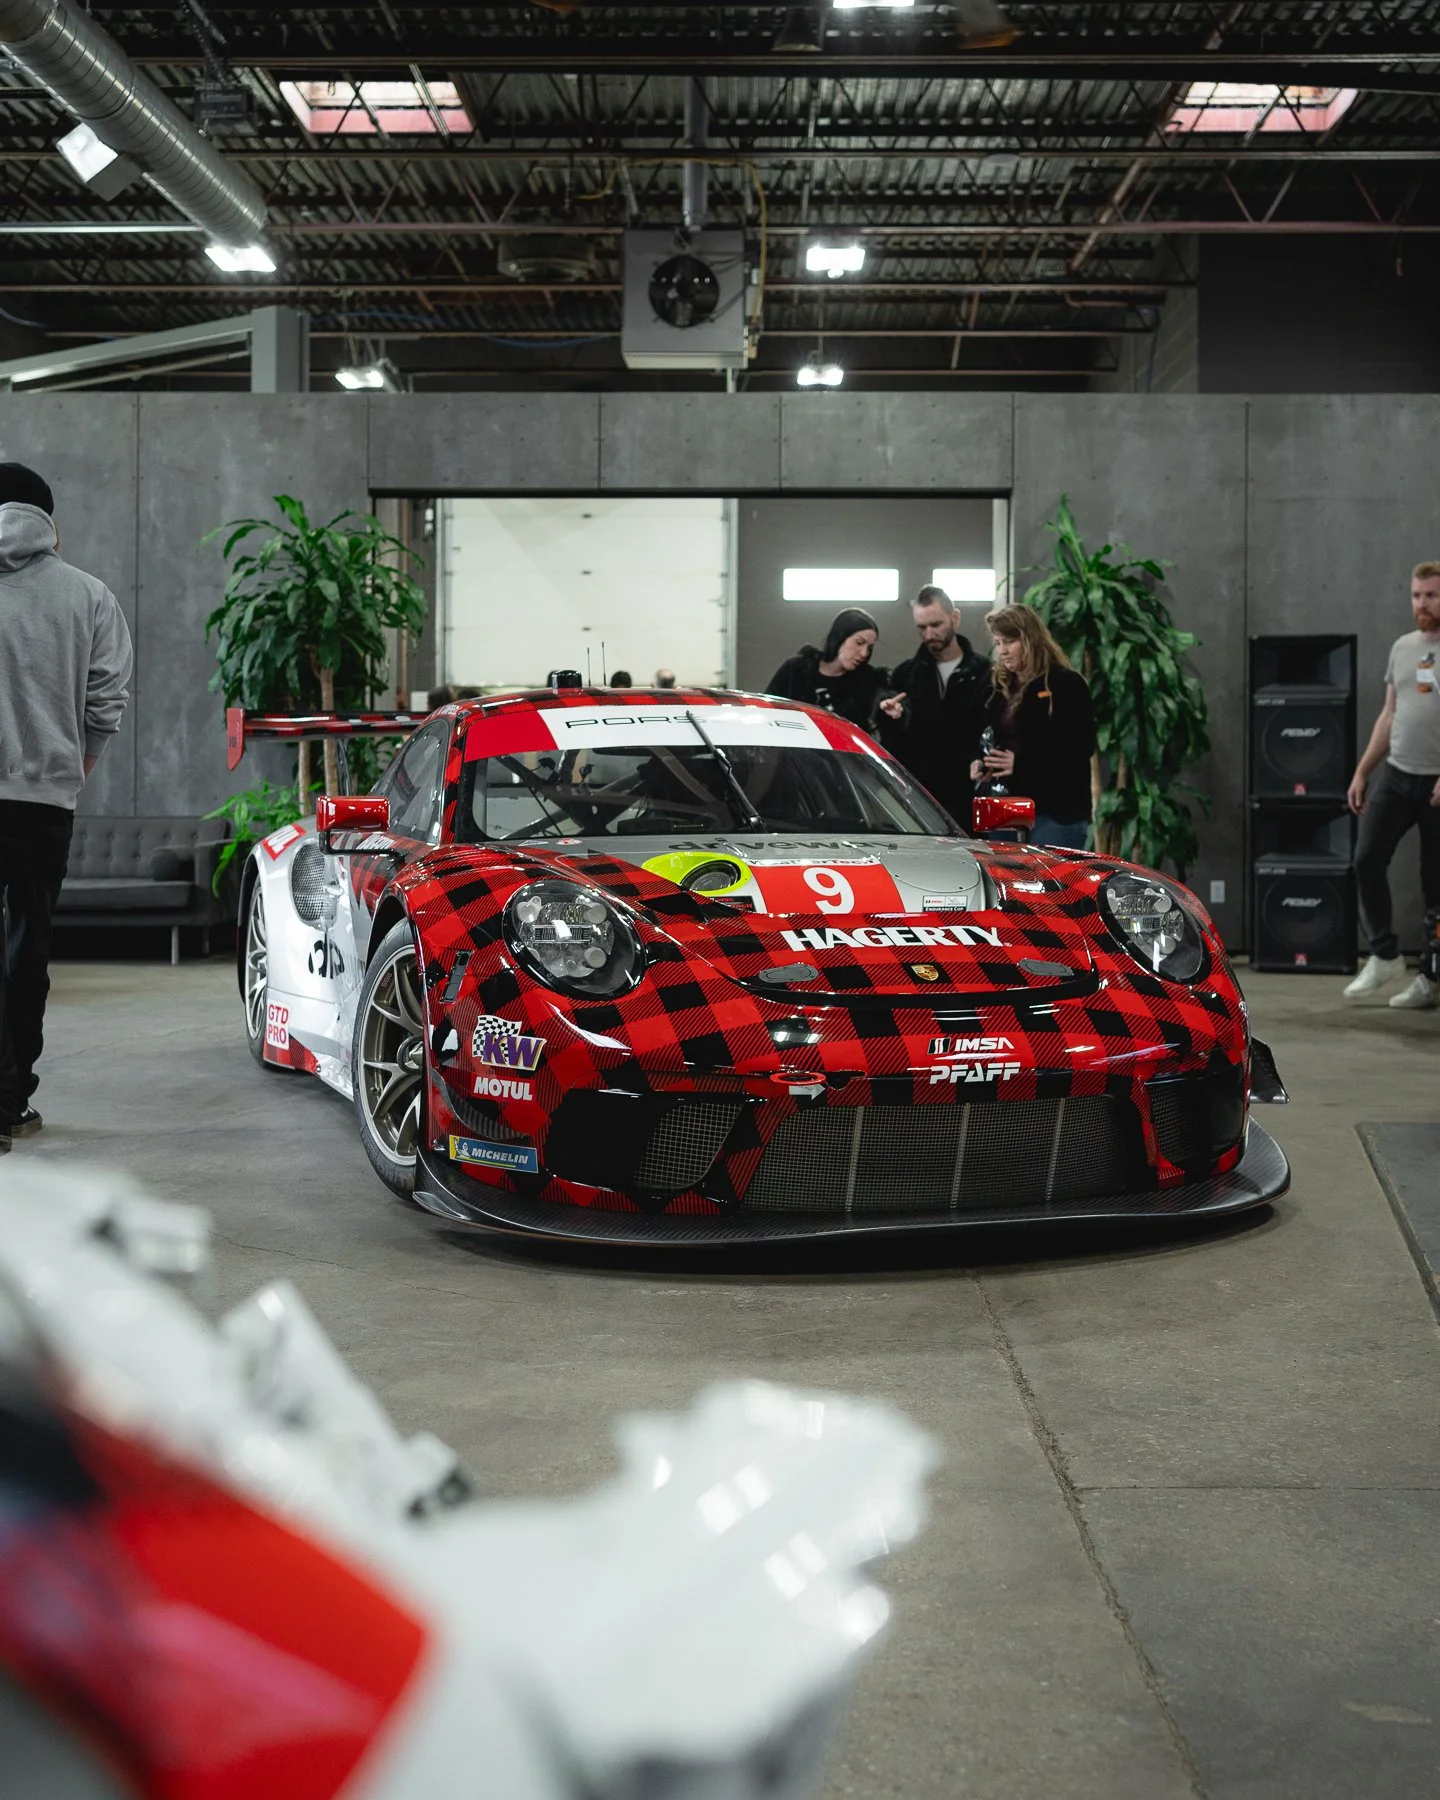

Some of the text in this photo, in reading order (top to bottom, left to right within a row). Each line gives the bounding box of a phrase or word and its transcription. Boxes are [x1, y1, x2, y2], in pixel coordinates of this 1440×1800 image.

[802, 866, 855, 915] 9
[779, 926, 1005, 952] HAGERTY
[268, 1003, 289, 1024] GTD
[267, 1023, 287, 1044] PRO
[955, 1037, 1015, 1051] IMSA
[482, 1032, 541, 1068] KW
[929, 1062, 1021, 1085] PFAFF
[474, 1076, 533, 1101] MOTUL
[472, 1147, 529, 1165] MICHELIN
